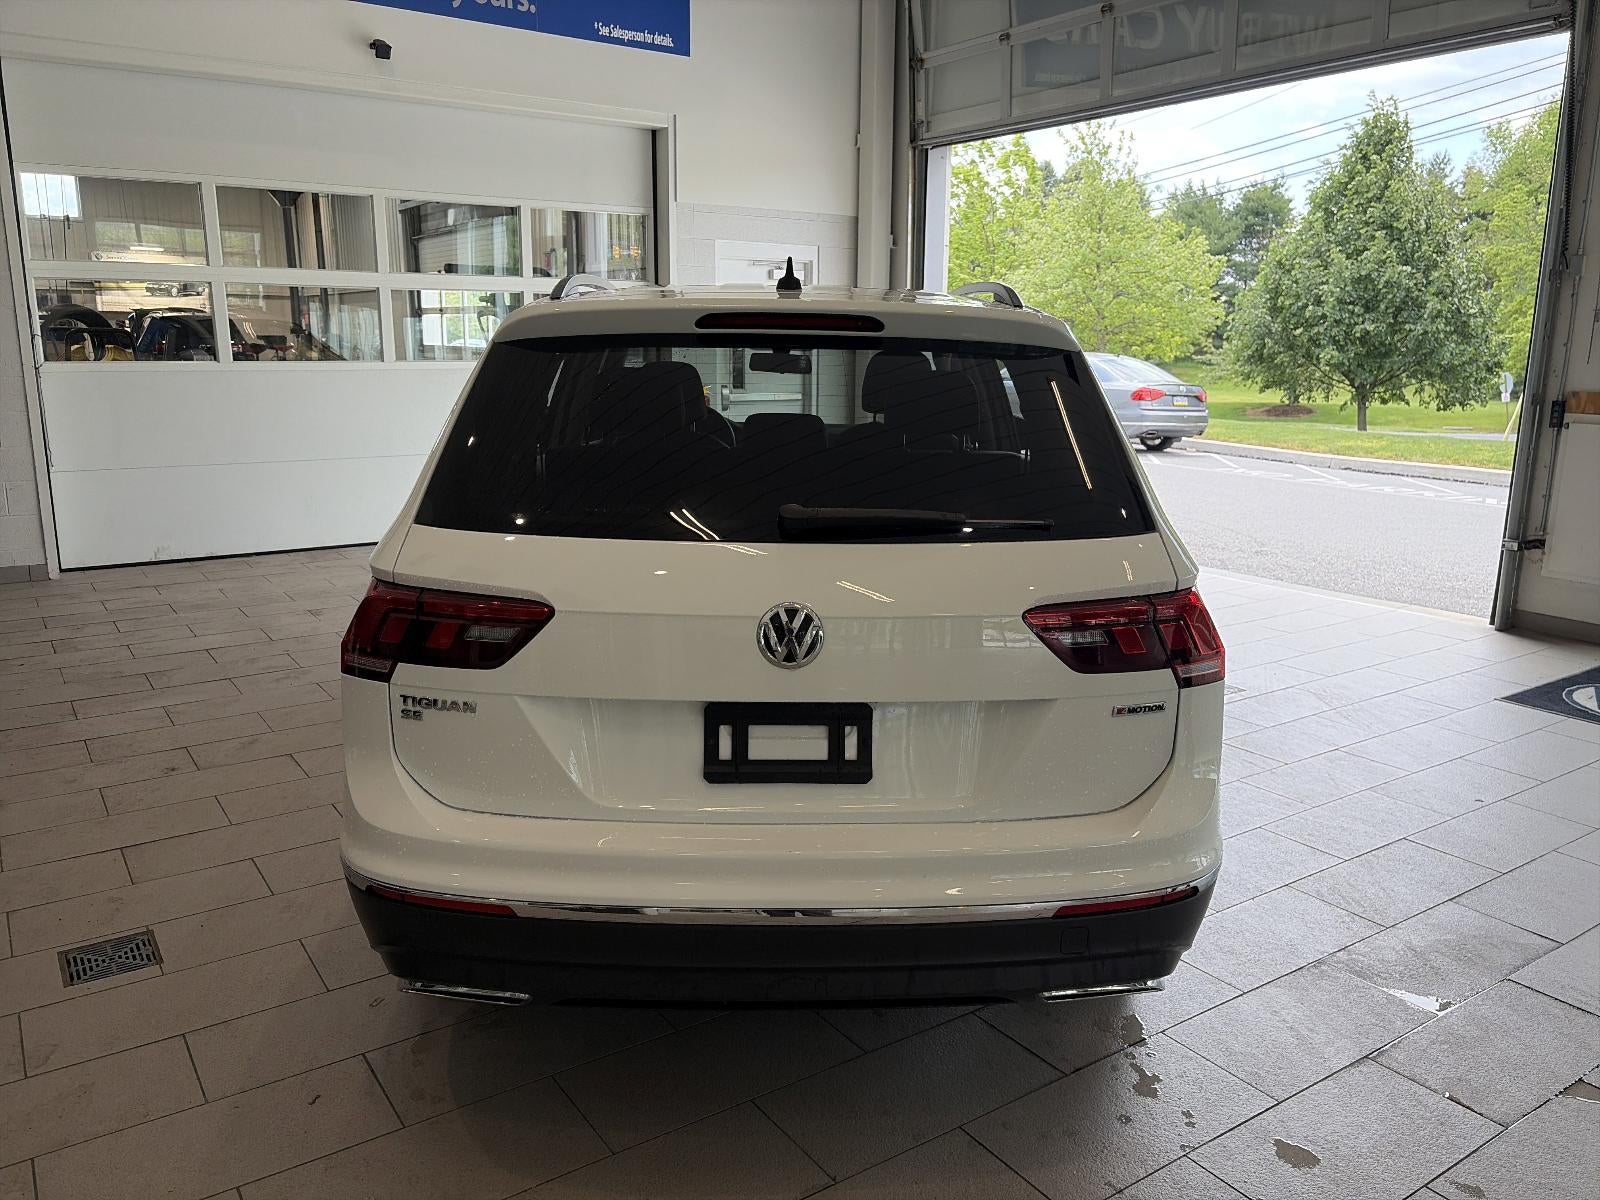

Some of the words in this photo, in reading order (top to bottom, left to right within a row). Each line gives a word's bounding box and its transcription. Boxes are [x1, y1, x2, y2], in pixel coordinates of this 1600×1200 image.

[610, 24, 645, 42] Salesperson
[645, 29, 654, 43] for
[654, 31, 674, 47] details.
[400, 694, 477, 713] TIGUAN
